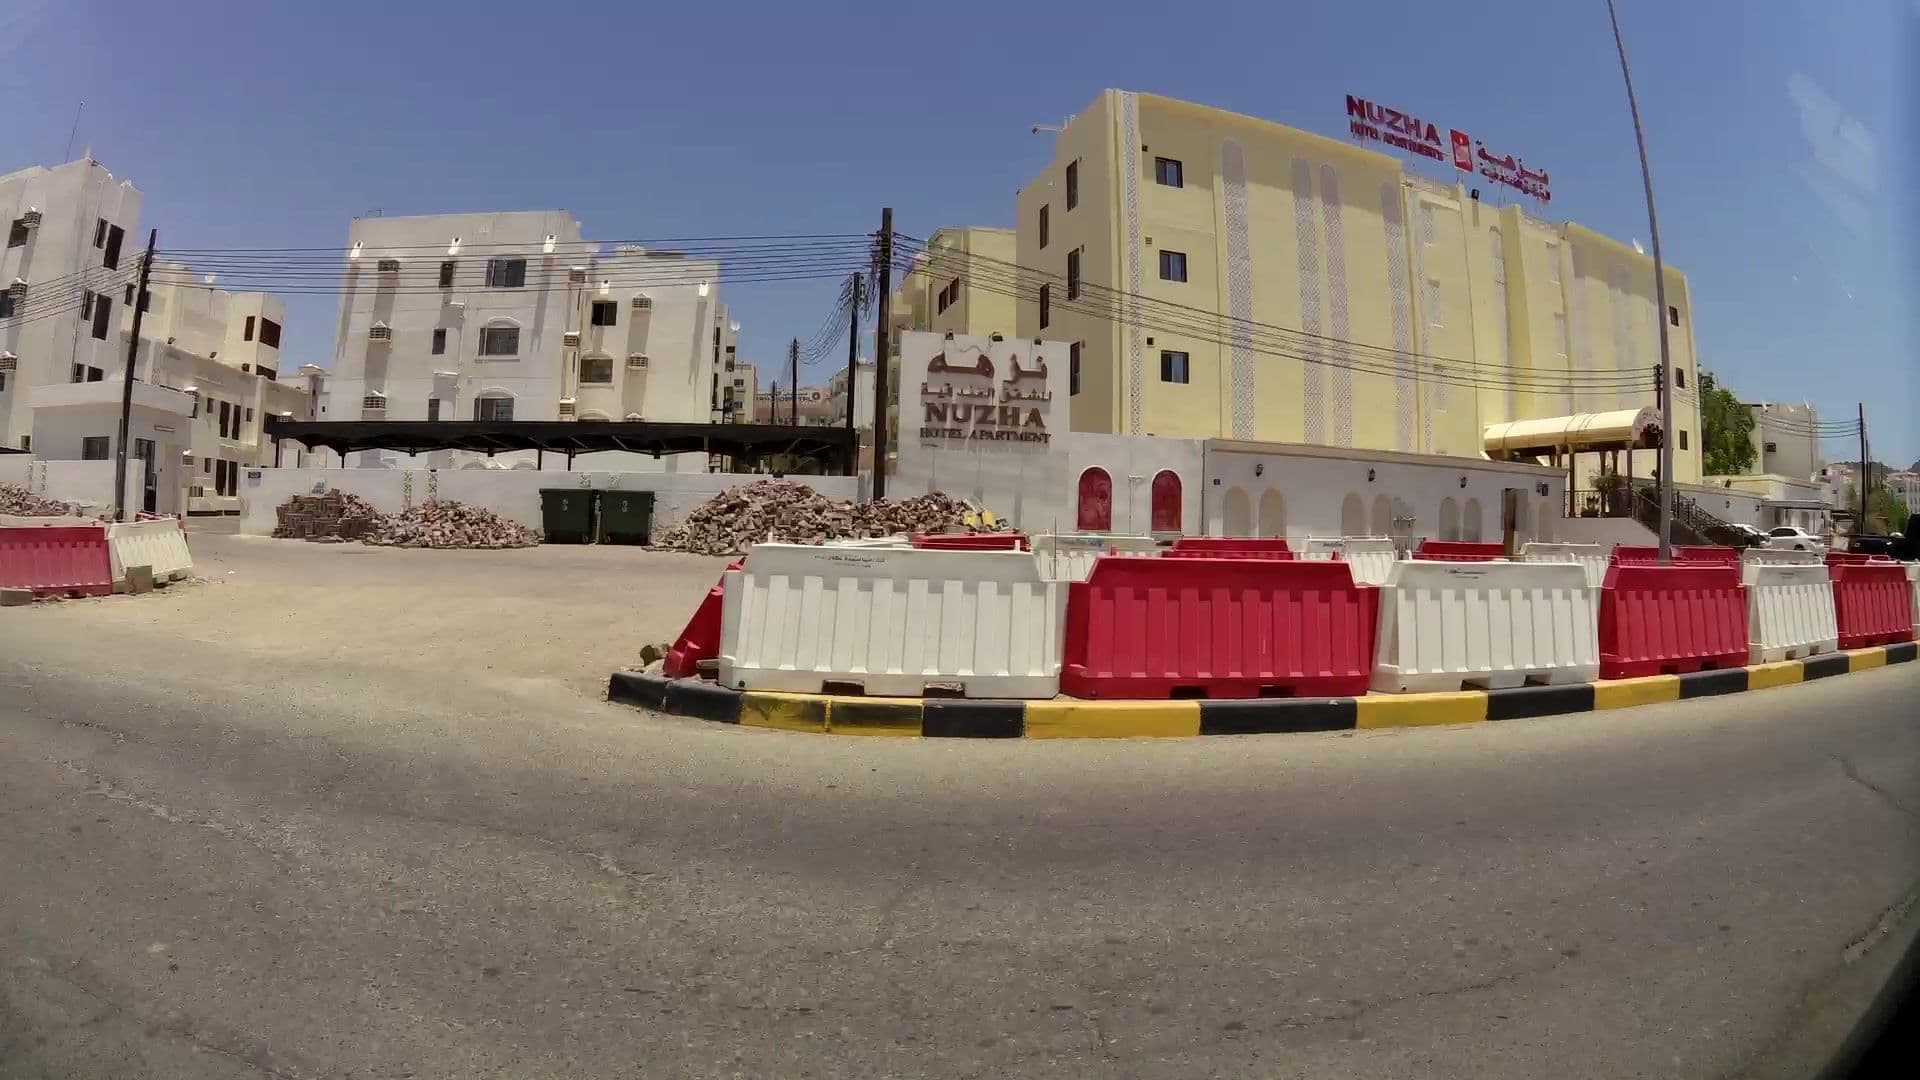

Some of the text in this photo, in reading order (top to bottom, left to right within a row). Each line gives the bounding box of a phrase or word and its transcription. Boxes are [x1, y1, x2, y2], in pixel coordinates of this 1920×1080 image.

[1345, 94, 1442, 147] NUZHA
[926, 402, 1046, 429] NUZHA
[920, 427, 1052, 444] HOTEL APARTMENT
